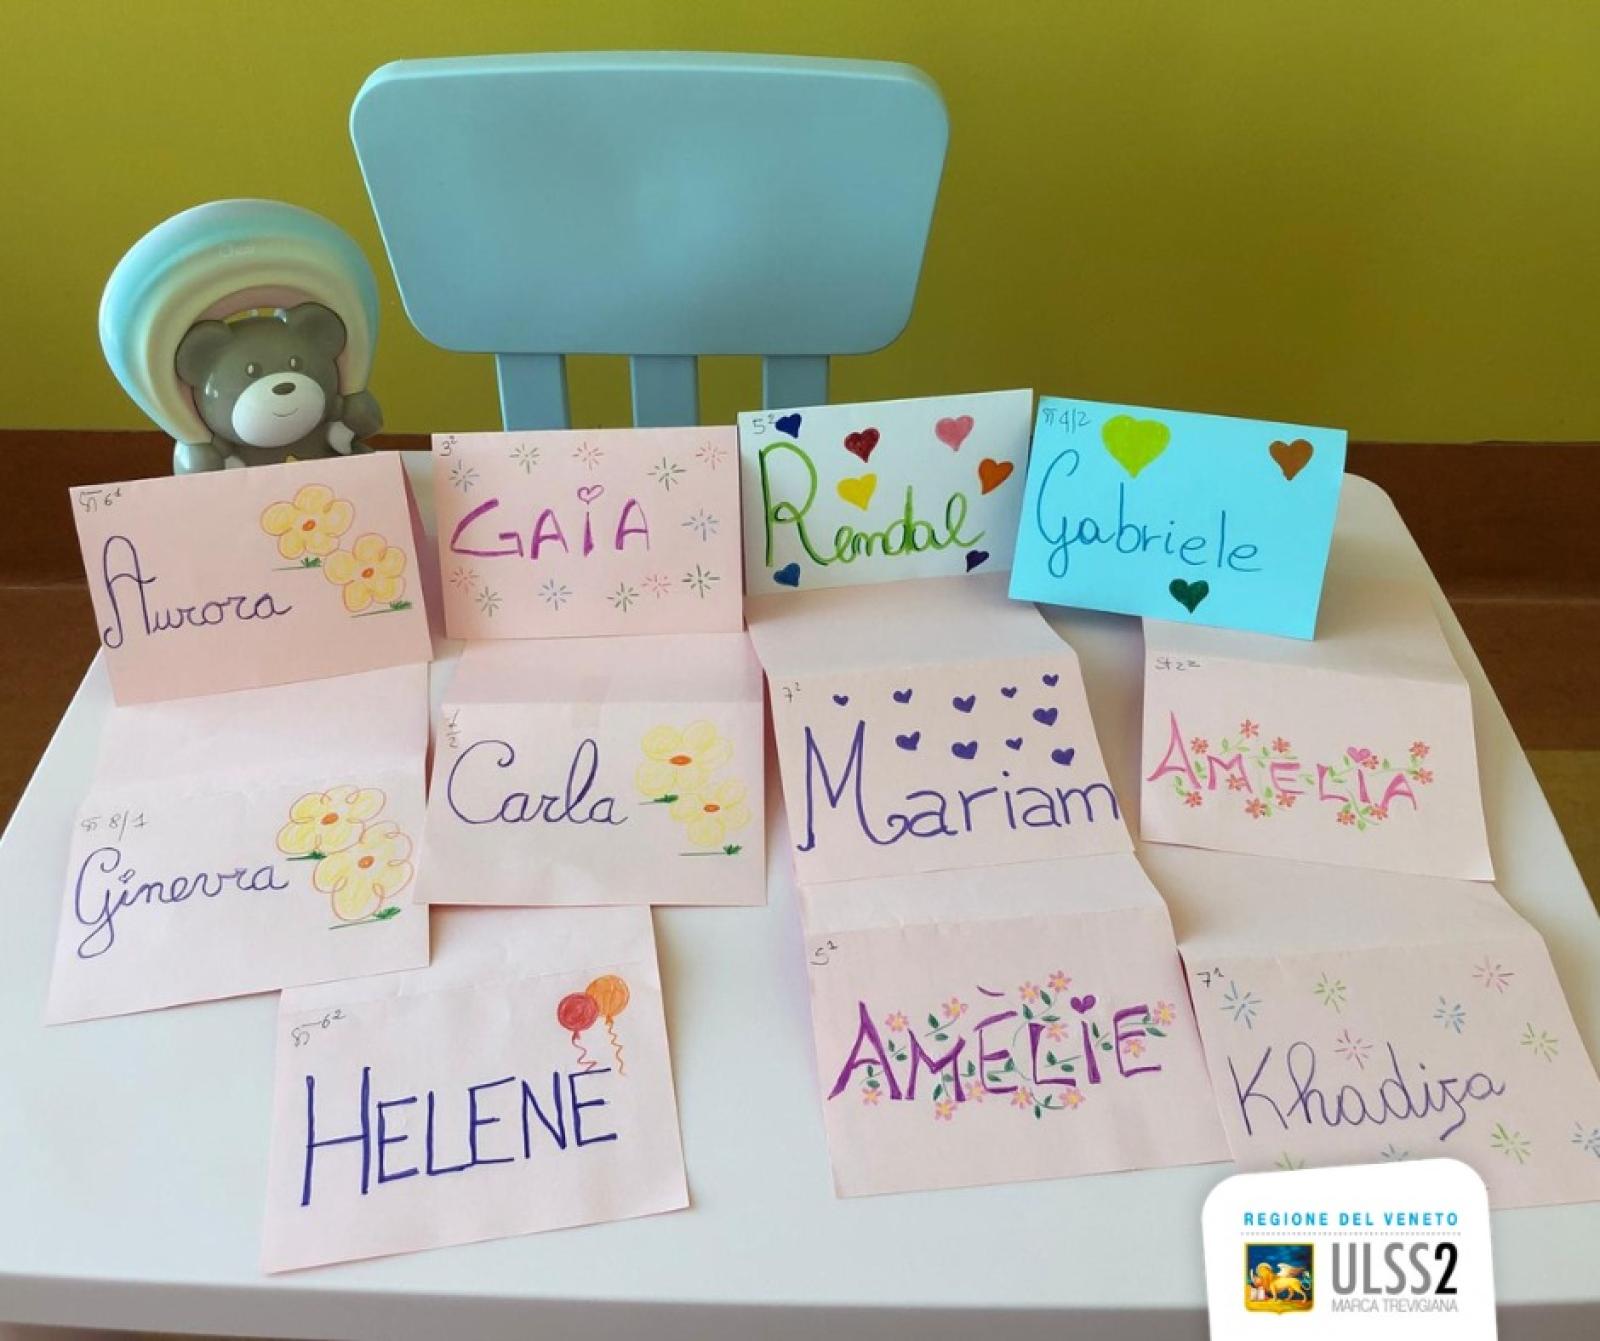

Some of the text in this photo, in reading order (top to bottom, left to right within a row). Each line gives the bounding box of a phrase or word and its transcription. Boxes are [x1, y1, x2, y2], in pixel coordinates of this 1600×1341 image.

[759, 441, 985, 567] Rendal
[1036, 448, 1263, 578] Gabriele
[103, 535, 292, 649] Aurora
[447, 738, 628, 826] Carla
[797, 720, 1120, 851] Mariam
[1146, 710, 1417, 813] AMELIA
[75, 846, 290, 959] Ginevra
[301, 1066, 618, 1207] HELENE
